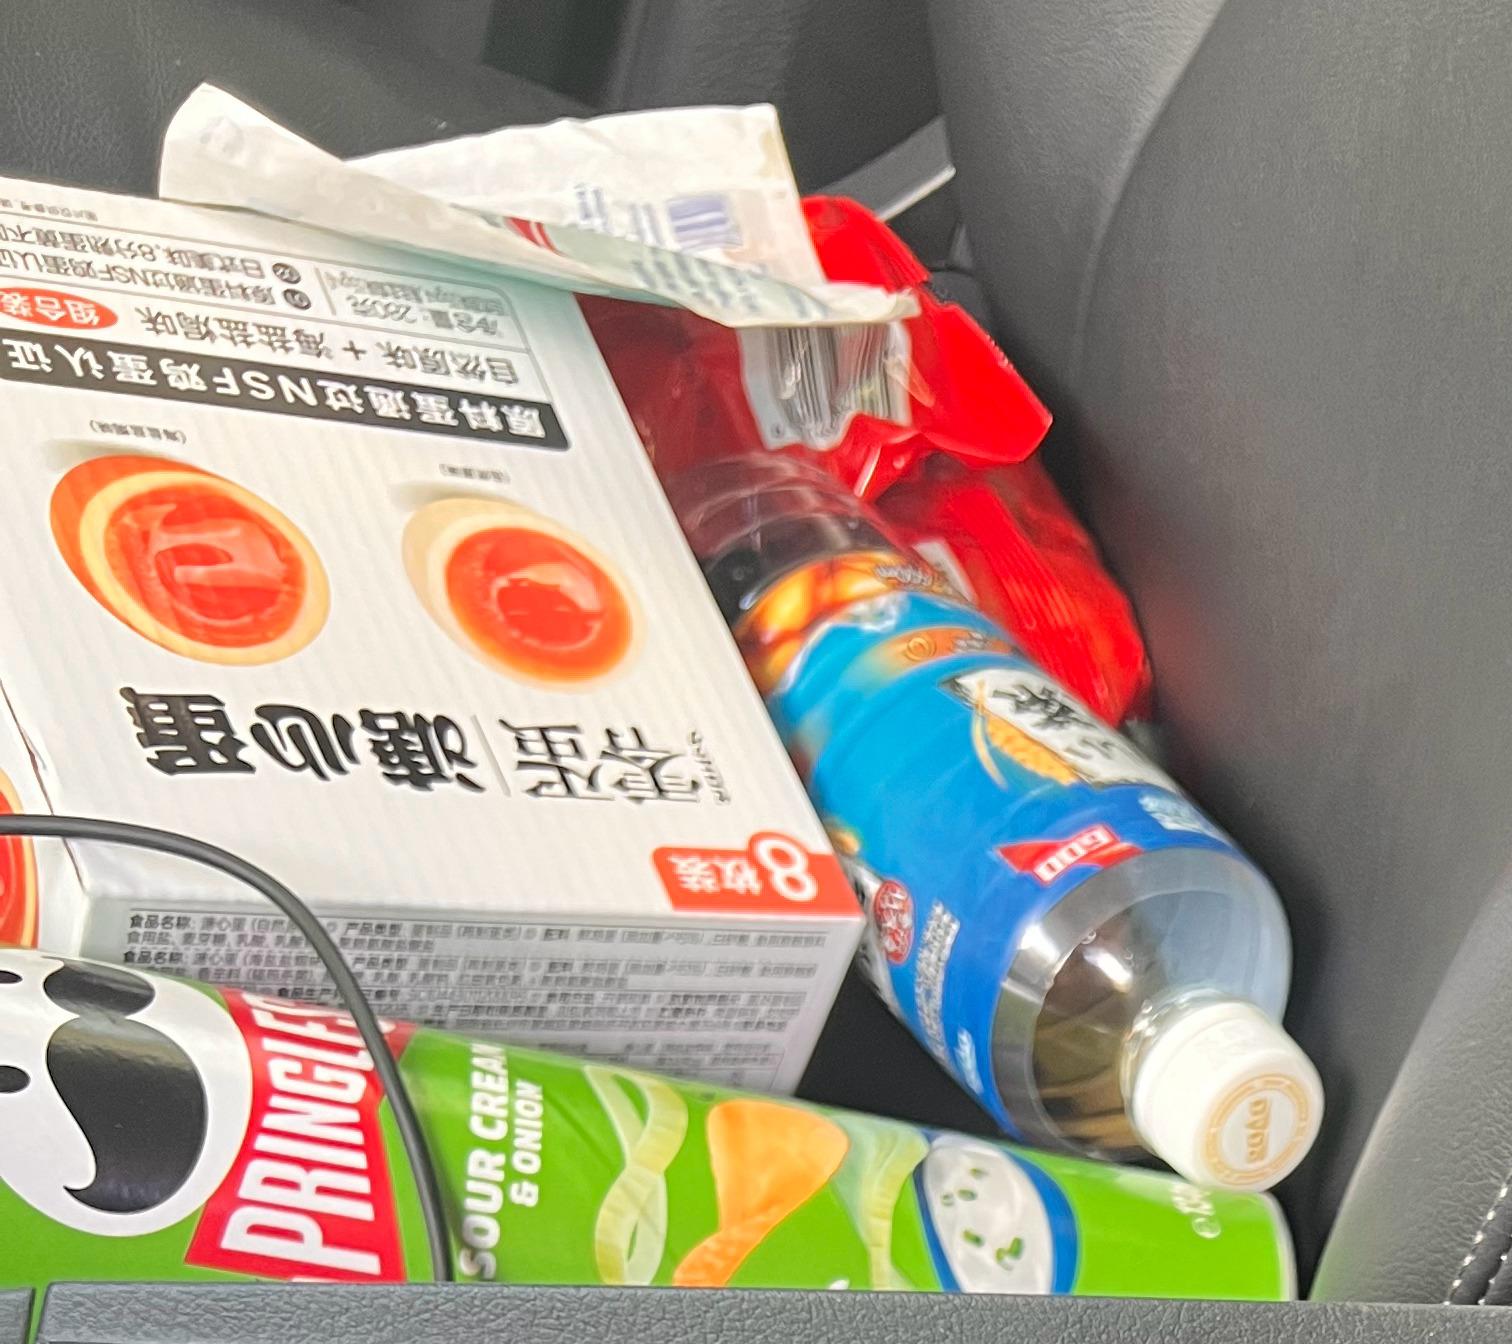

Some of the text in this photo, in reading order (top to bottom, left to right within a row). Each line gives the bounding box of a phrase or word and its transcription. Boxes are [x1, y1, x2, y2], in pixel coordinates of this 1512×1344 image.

[0, 291, 101, 326] 组合装
[2, 338, 547, 438] 原料蛋通过NSF鸡蛋认证
[378, 339, 520, 385] 自然原味
[672, 837, 818, 901] 8枚装
[219, 992, 396, 1277] PRINGLES
[509, 1079, 544, 1208] & ONION
[460, 1148, 507, 1281] SOUR
